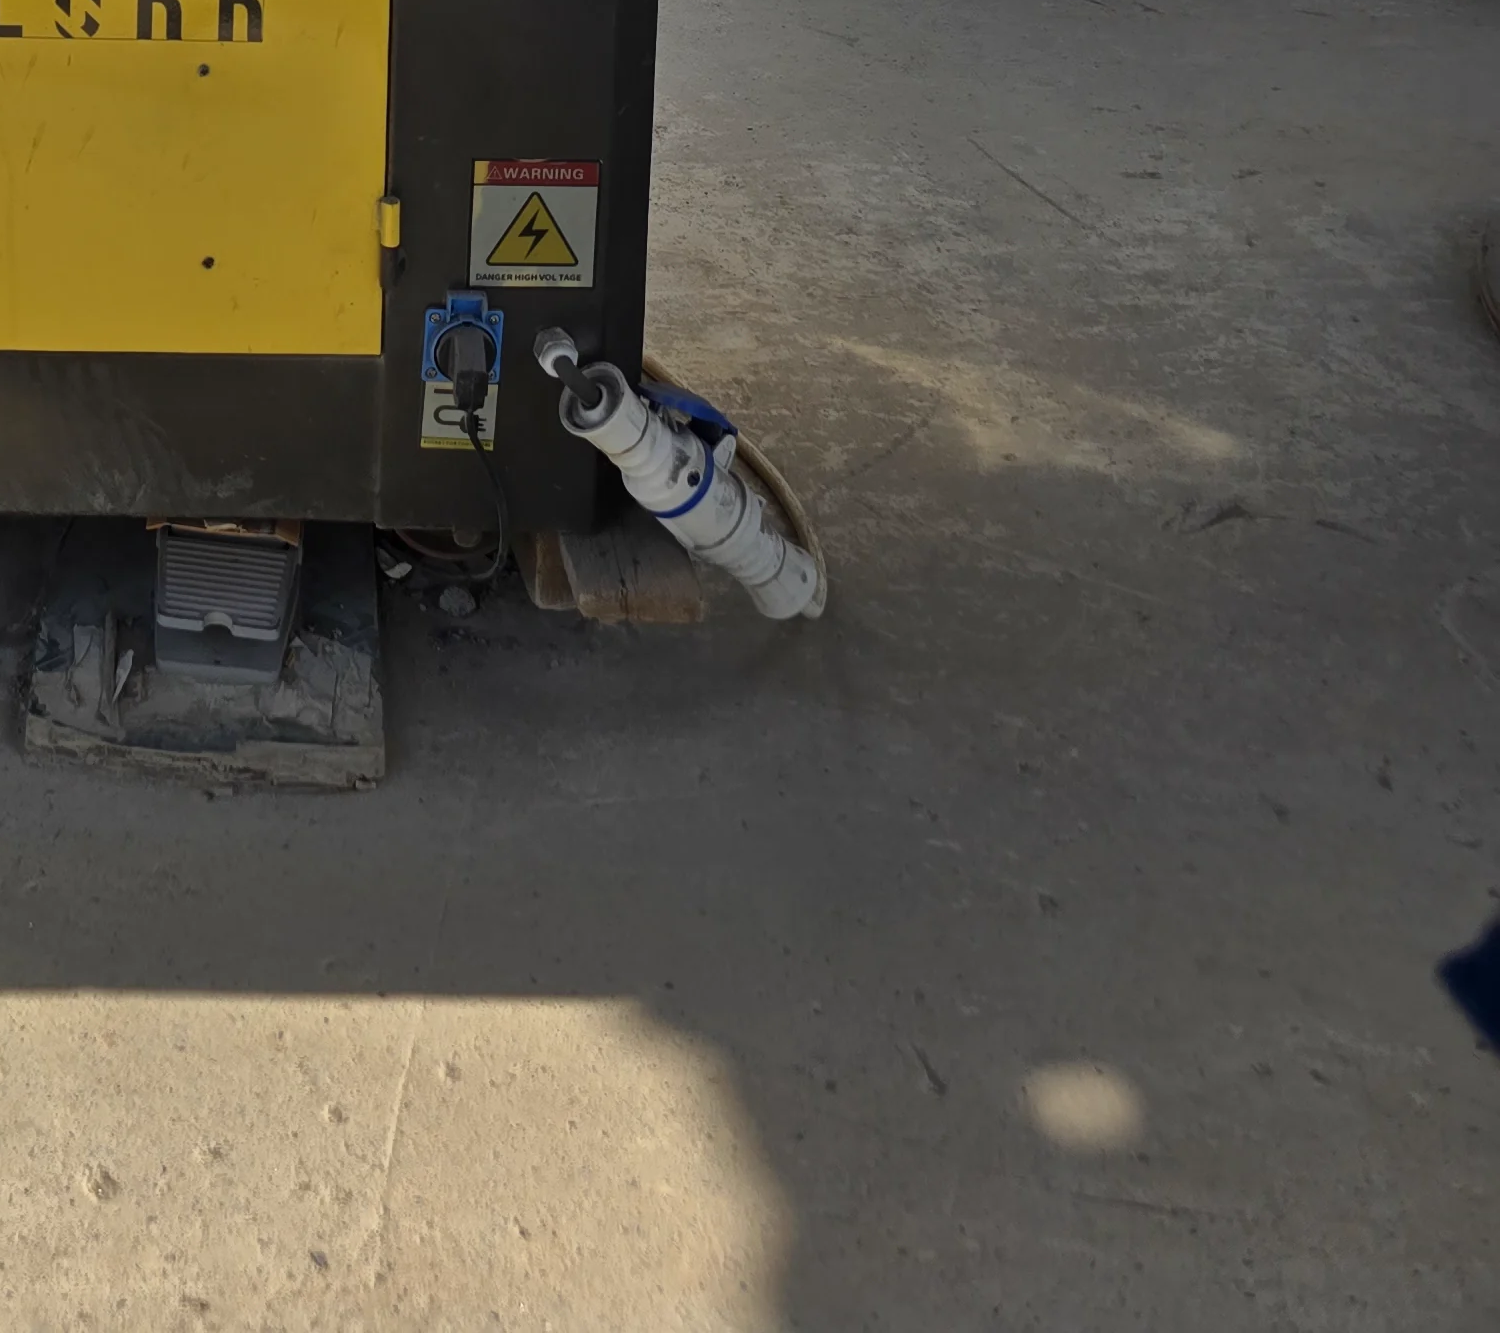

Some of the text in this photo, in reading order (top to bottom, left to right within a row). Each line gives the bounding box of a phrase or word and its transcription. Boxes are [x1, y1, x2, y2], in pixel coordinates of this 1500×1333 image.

[503, 167, 584, 180] WARNING
[476, 274, 513, 282] DANGER
[514, 274, 538, 282] HIGH
